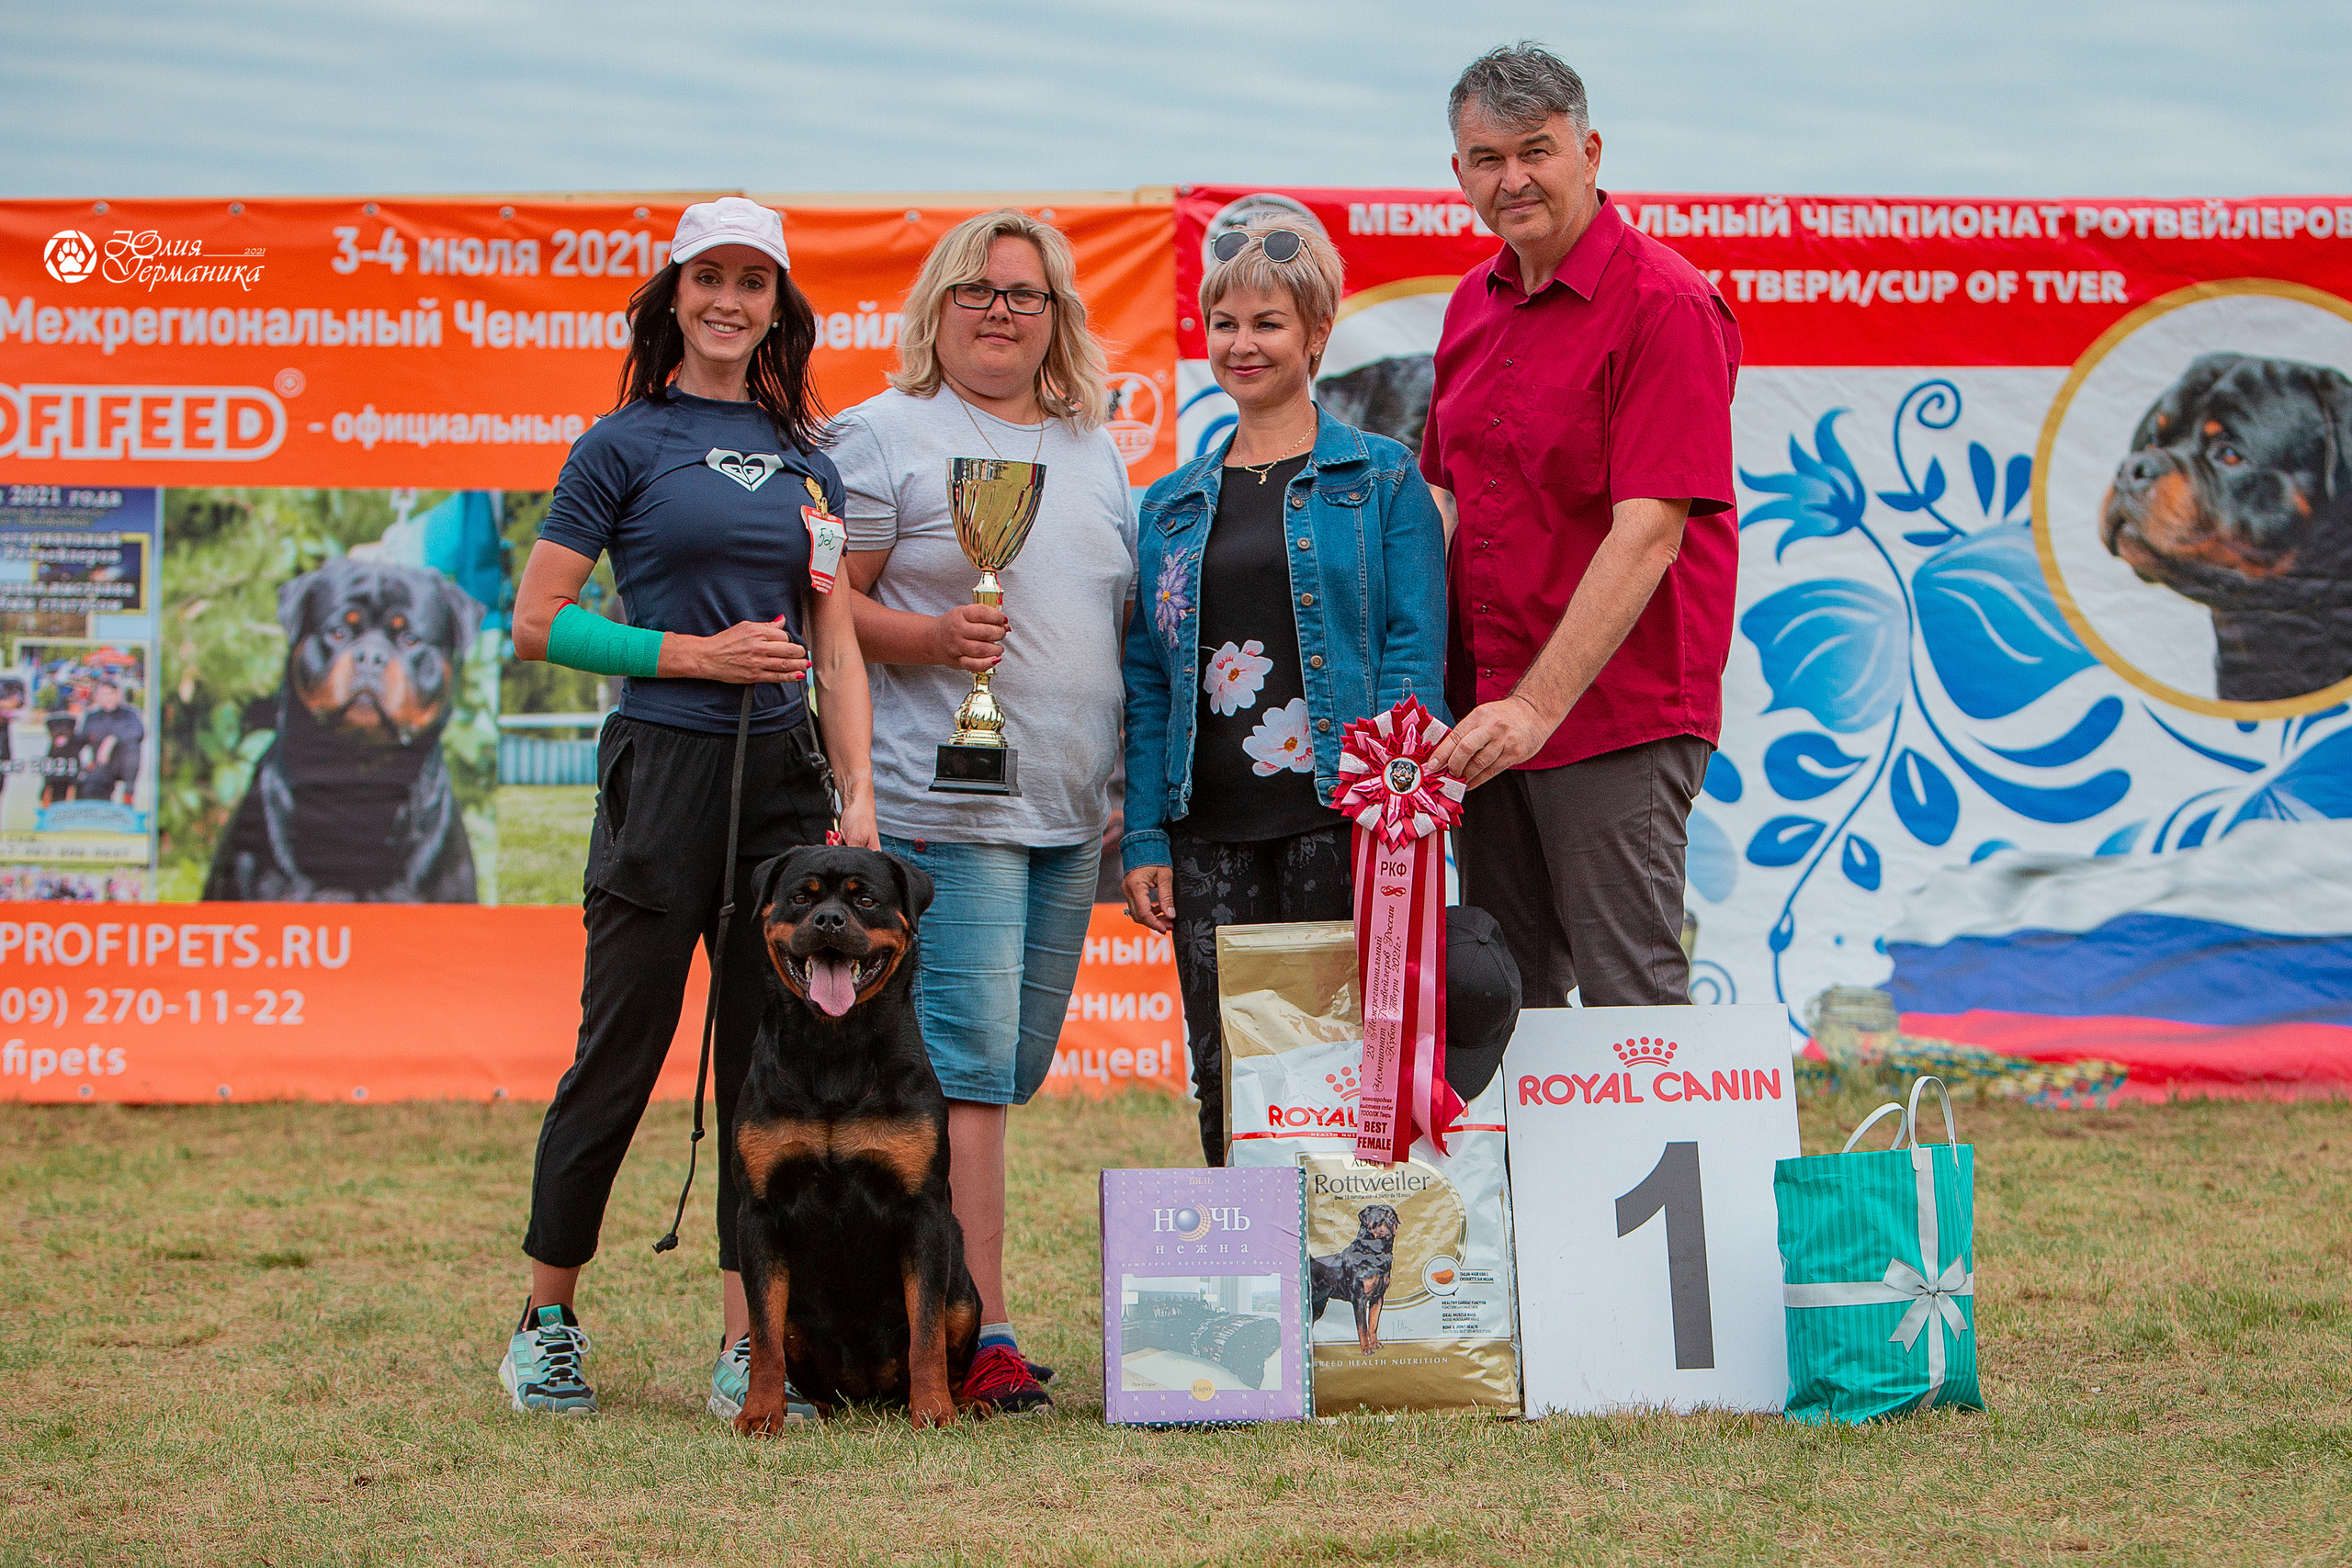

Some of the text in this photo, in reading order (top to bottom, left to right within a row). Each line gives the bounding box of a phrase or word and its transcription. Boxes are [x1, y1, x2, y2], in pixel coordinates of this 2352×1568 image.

[1802, 204, 2067, 239] ЧЕМПИОНАТ
[2074, 198, 2352, 239] РОТВЕЙЛЕРОВ
[332, 226, 407, 276] 3-4
[418, 238, 538, 276] июля
[1729, 269, 1959, 307] ТВЕРИ/CUP
[1965, 270, 2018, 304] OF
[2020, 270, 2129, 305] TVER
[0, 296, 443, 355] Межрегиональный
[332, 404, 584, 449] официальные
[8, 485, 62, 507] 2021
[1380, 861, 1408, 877] РКФ
[0, 921, 351, 969] PROFIPETS.RU
[83, 987, 305, 1025] 270-11-22
[1365, 935, 1383, 1060] 23 Межрегиональный
[1373, 905, 1395, 1092] Чемпионат Ротвейлеров России
[1388, 978, 1400, 1017] Твери
[1, 1039, 127, 1084] fipets
[1518, 1068, 1781, 1106] ROYAL CANIN
[1268, 1104, 1358, 1128] ROYAL
[1363, 1121, 1387, 1134] BEST
[1357, 1136, 1392, 1150] FEMALE
[1188, 1177, 1215, 1185] БЯЗЬ
[1314, 1170, 1430, 1194] Rottweiler
[1614, 1141, 1715, 1370] 1
[1349, 1359, 1386, 1367] HEALTH
[1392, 1357, 1449, 1366] NUTRITION
